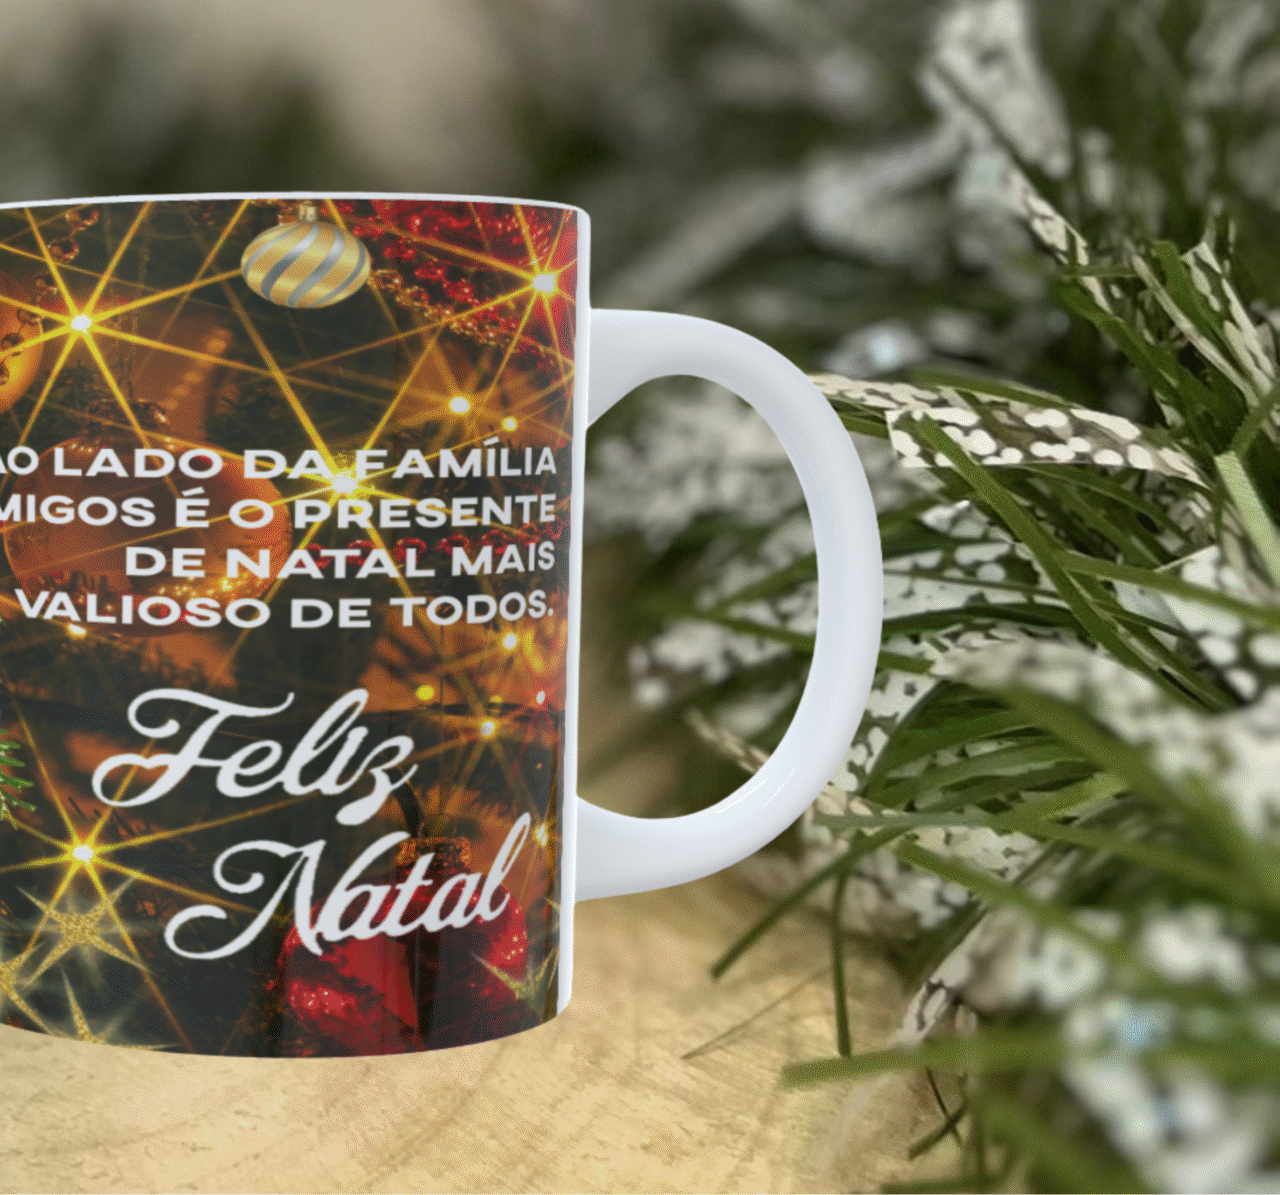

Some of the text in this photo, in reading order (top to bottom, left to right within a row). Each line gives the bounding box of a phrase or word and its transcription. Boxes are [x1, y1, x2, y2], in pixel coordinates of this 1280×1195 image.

[54, 447, 223, 479] LADO
[243, 449, 333, 479] DA
[355, 436, 557, 479] FAMÍLIA
[175, 486, 210, 528] É
[228, 498, 274, 529] O
[294, 493, 557, 529] PRESENTE
[125, 540, 556, 579] DE NATAL MAIS
[14, 588, 554, 629] VALIOSO DE TODOS.
[92, 688, 418, 826] Feliz
[165, 812, 531, 960] Natal
